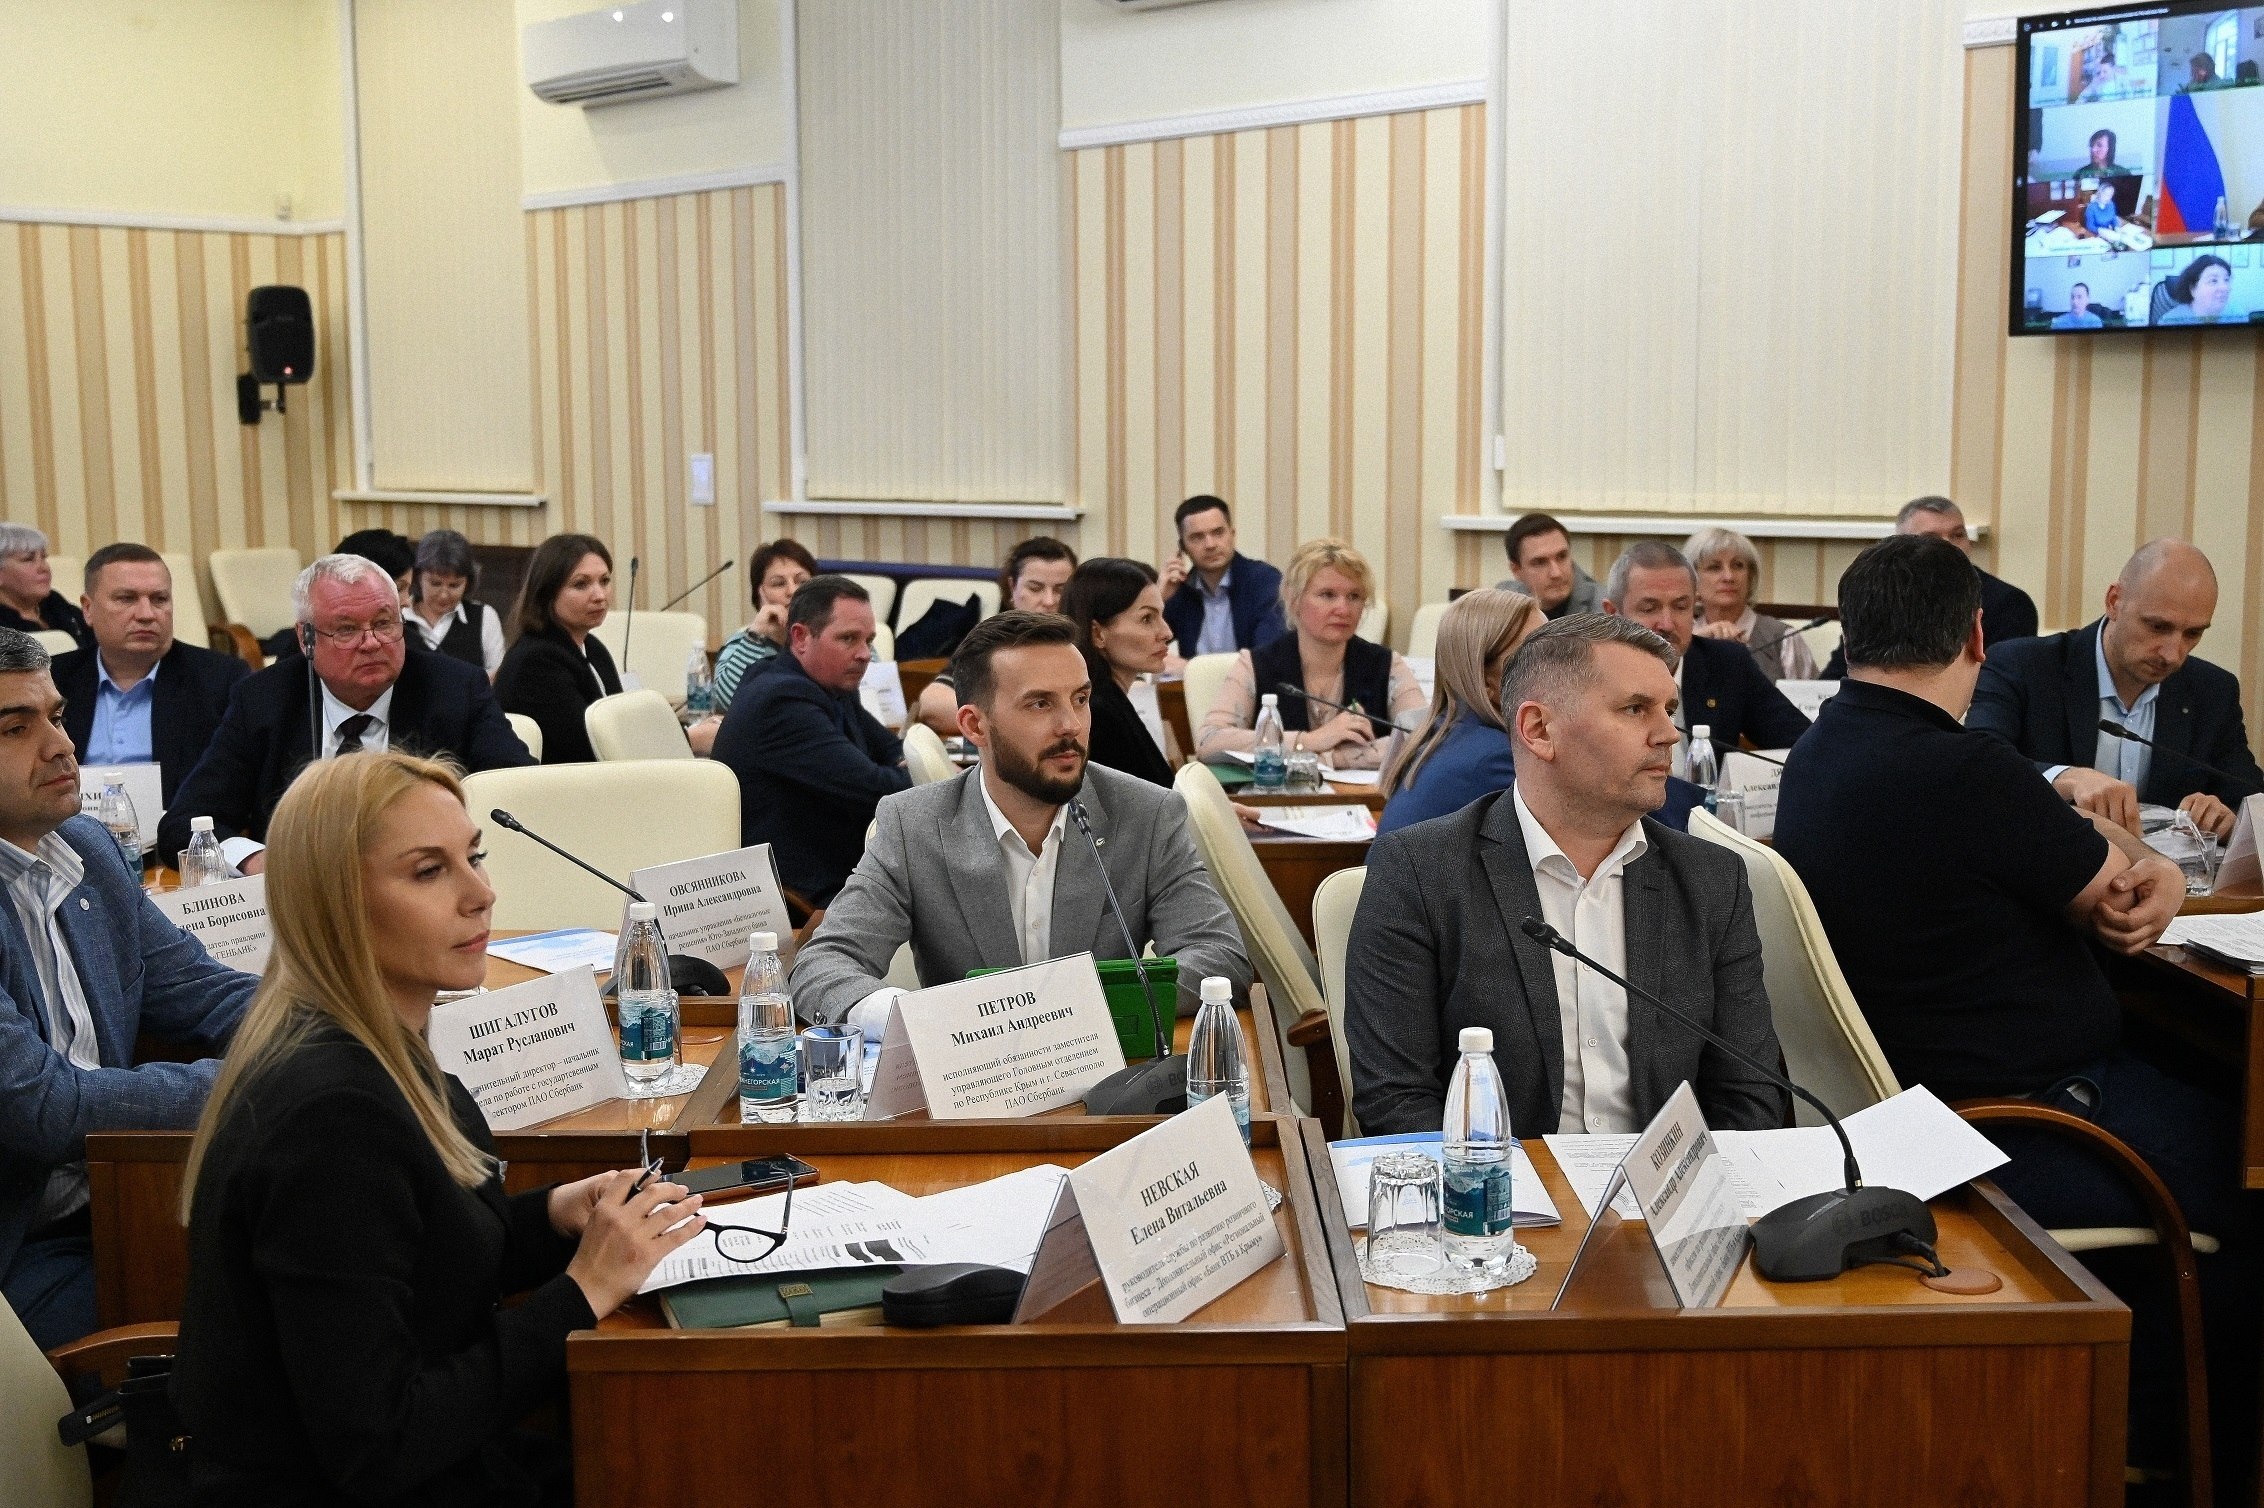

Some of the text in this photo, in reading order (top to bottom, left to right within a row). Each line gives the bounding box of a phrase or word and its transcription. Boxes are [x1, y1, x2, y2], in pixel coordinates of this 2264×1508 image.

[669, 870, 747, 897] ОВСЯННИКОВА
[182, 892, 246, 915] БЛИНОВА
[663, 884, 762, 918] Ирина Александровна
[179, 907, 266, 932] лена Борисовна
[206, 941, 230, 951] датель
[468, 1002, 558, 1040] ШИГАЛУГОВ
[977, 991, 1036, 1018] ПЕТРОВ
[463, 1021, 576, 1065] Марат Русланович
[951, 1006, 1074, 1047] Михаил Андреевич
[522, 1060, 557, 1080] директор
[563, 1046, 600, 1066] начальник
[942, 1057, 1002, 1082] исполняющий
[1003, 1045, 1052, 1066] обязанности
[1052, 1032, 1099, 1052] заместителя
[951, 1046, 1099, 1097] управляющего Головным отделением
[493, 1092, 504, 1103] по
[504, 1085, 530, 1102] работе
[531, 1082, 537, 1090] с
[528, 1091, 548, 1107] ПАО
[548, 1081, 584, 1100] Сбербанк
[953, 1099, 965, 1110] по
[966, 1085, 1013, 1106] Республике
[1014, 1077, 1038, 1093] Крым
[1039, 1074, 1045, 1084] и
[1054, 1060, 1105, 1081] Севастополю
[1004, 1085, 1066, 1110] ПАО Сбербанк
[1140, 1160, 1201, 1208] НЕВСКАЯ
[1130, 1179, 1228, 1246] Елена Витальевна
[1220, 1248, 1235, 1268] ВТБ
